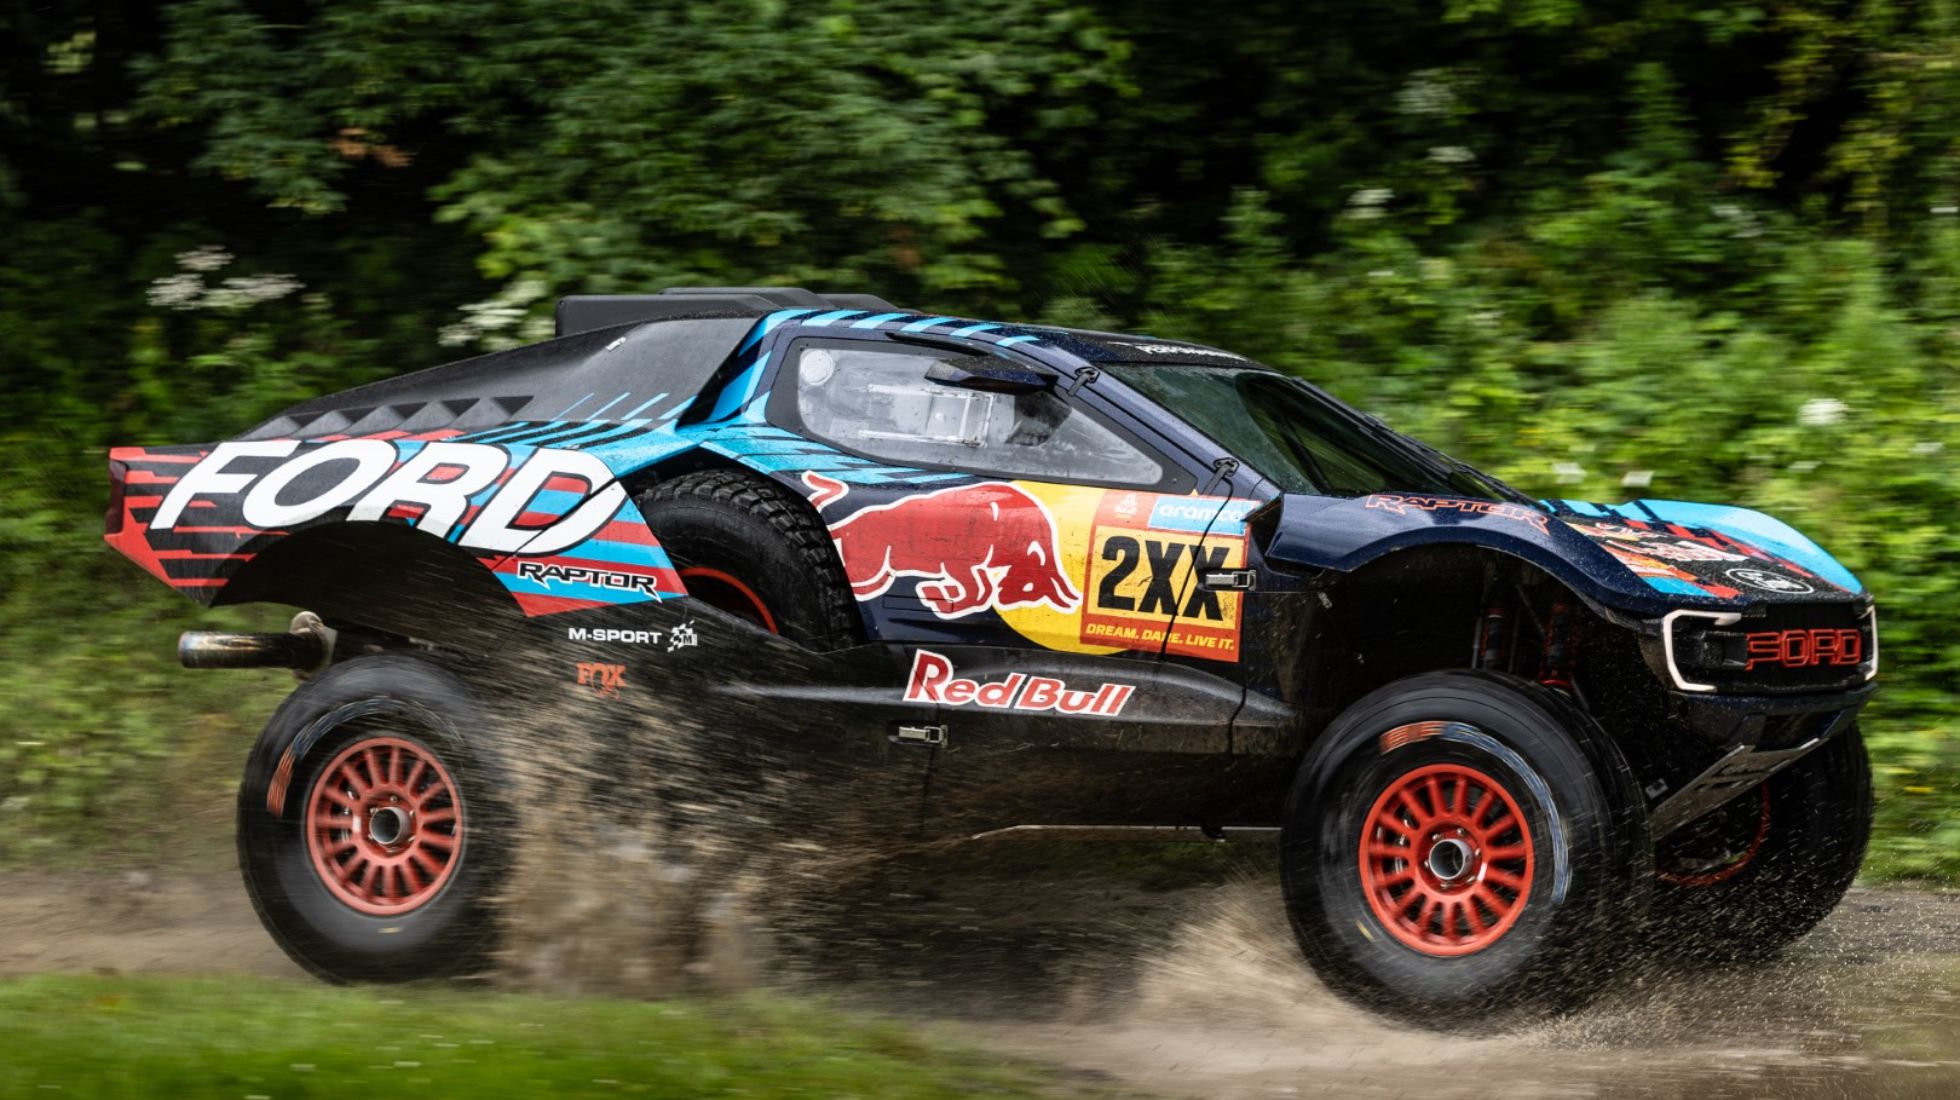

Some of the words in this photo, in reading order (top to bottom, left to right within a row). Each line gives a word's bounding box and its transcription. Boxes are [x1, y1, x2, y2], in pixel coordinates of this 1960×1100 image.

[149, 439, 630, 554] FORD
[1160, 503, 1243, 522] aramco
[1366, 494, 1549, 536] RAPTOR
[517, 561, 662, 603] RAPTOR
[1098, 536, 1230, 621] 2XX
[568, 627, 662, 644] M-SPORT
[1086, 623, 1139, 639] DREAM.
[1186, 634, 1217, 647] LIVE
[1219, 639, 1235, 650] IT.
[1745, 628, 1861, 671] FORD
[576, 662, 626, 700] FOX
[903, 648, 1027, 706] Red
[1014, 676, 1136, 717] Bull
